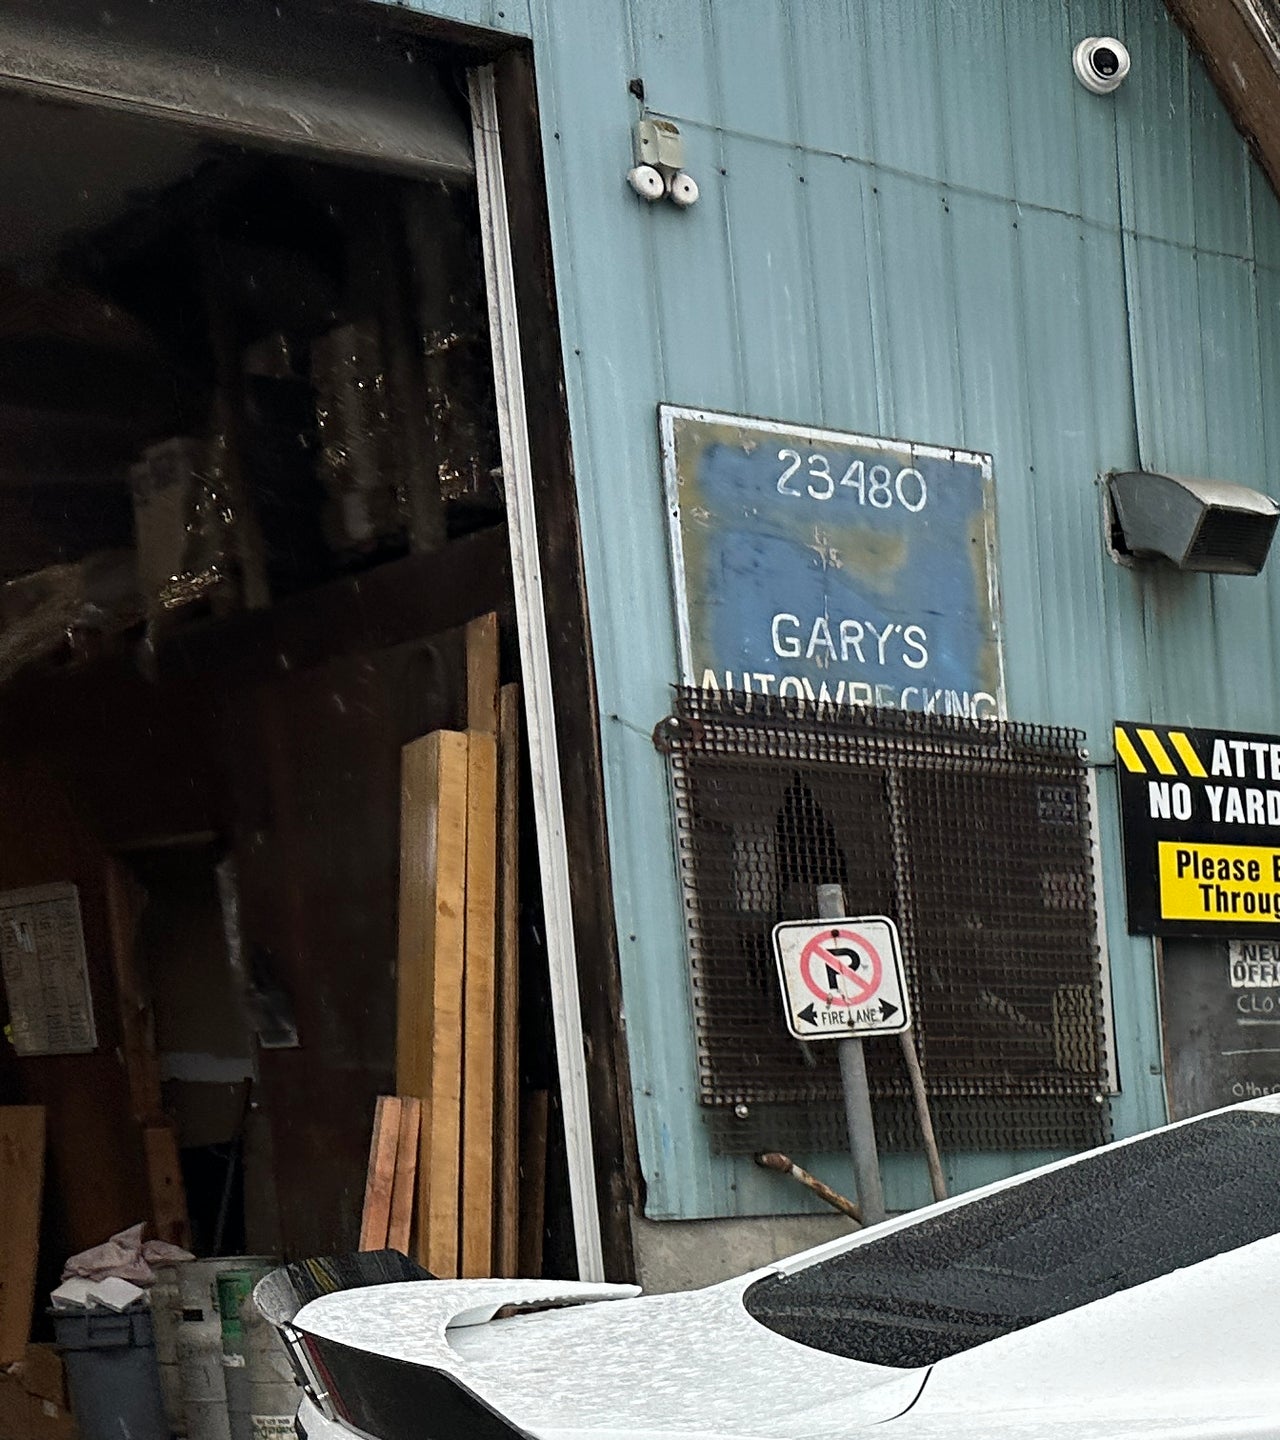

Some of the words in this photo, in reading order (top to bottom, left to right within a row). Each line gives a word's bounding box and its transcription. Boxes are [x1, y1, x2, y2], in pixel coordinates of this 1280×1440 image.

[776, 448, 927, 513] 23480
[771, 612, 928, 669] GARY'S
[1148, 781, 1192, 820] NO
[1175, 849, 1260, 882] Please
[821, 1011, 845, 1026] FIRE
